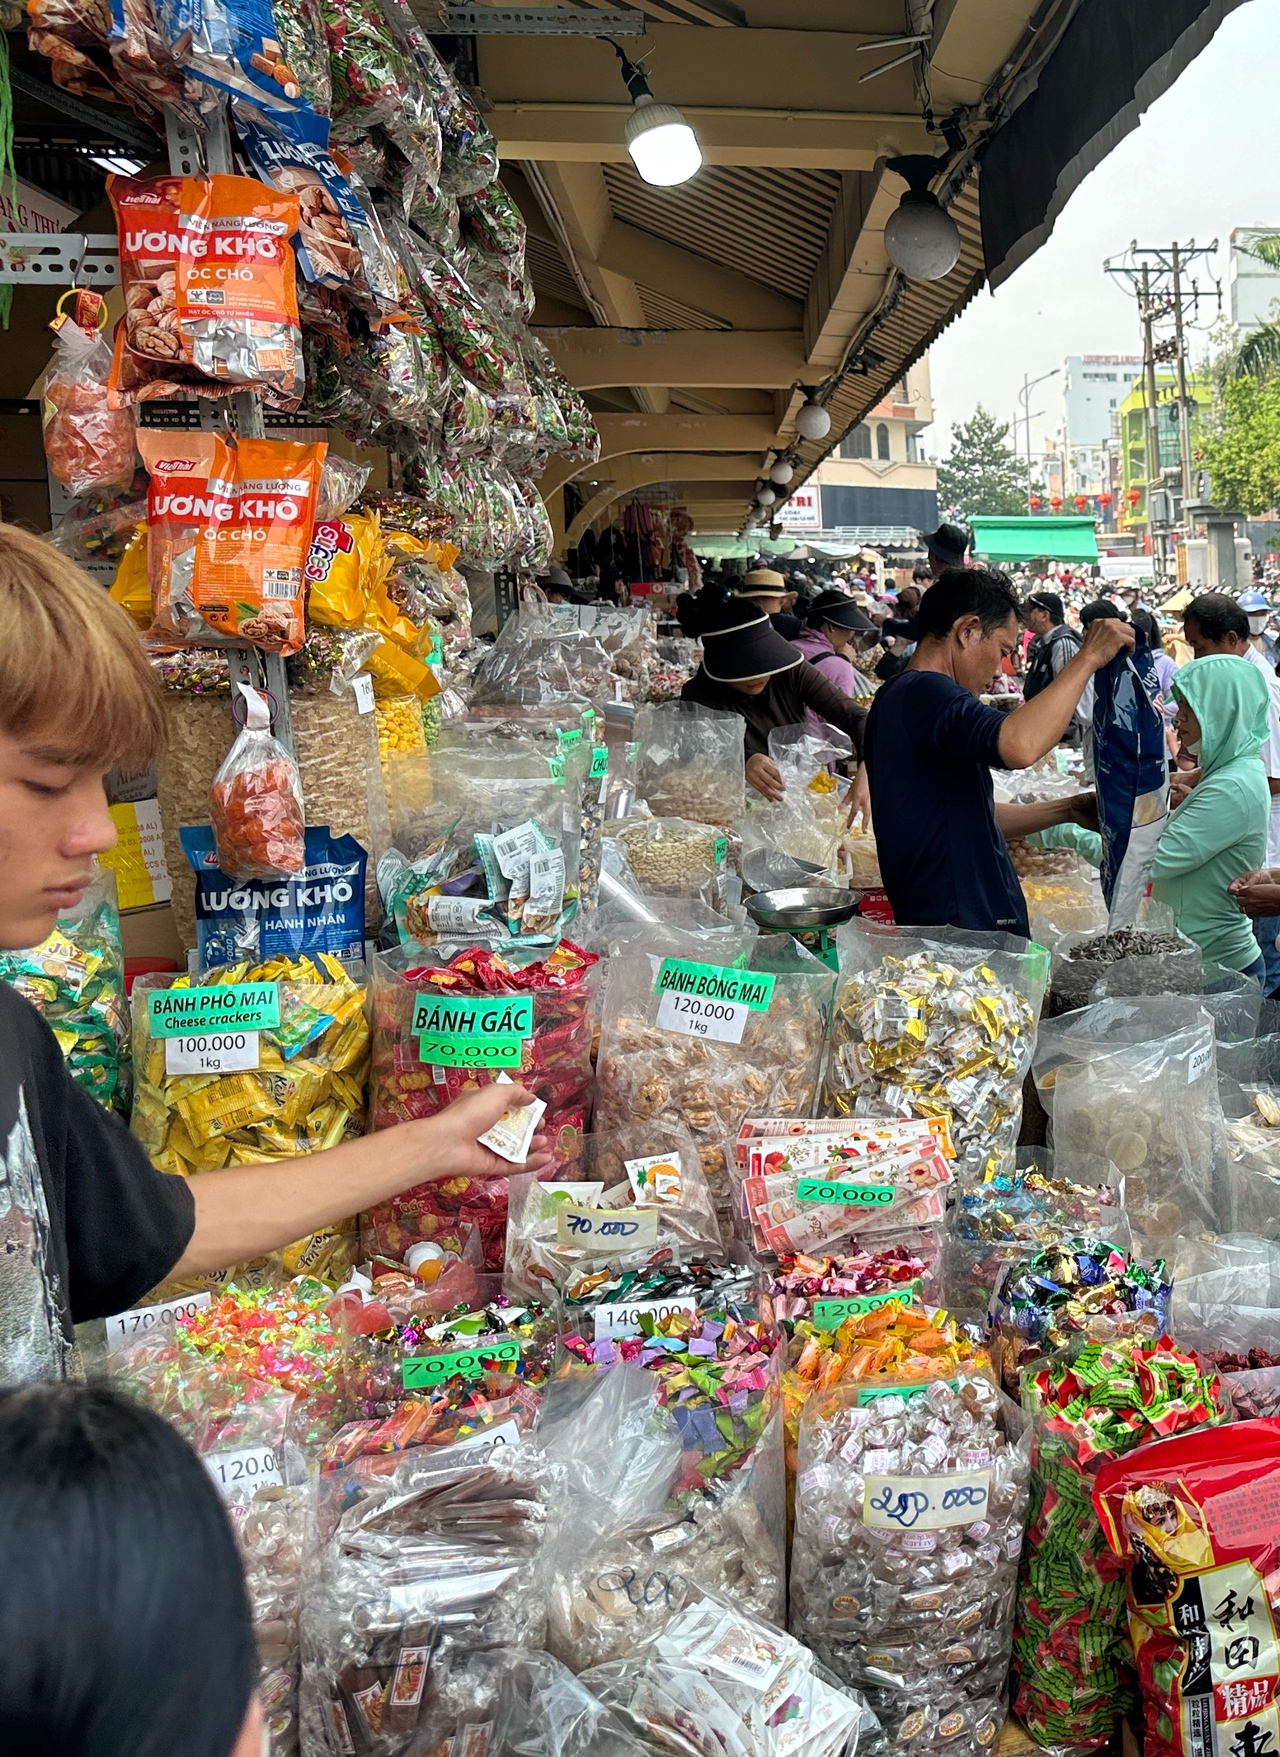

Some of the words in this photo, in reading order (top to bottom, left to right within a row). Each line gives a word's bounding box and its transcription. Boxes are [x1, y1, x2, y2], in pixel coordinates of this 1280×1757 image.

[125, 231, 206, 257] ƯƠNG
[215, 235, 278, 259] KHÔ
[239, 496, 300, 521] KHÔ
[201, 887, 289, 911] LƯƠNG
[297, 878, 353, 908] KHÔ
[265, 919, 304, 932] HẠNH
[308, 914, 346, 928] NHÂN
[660, 967, 697, 993] BÁNH
[696, 974, 739, 1000] BÔNG
[738, 982, 768, 1005] MAI
[153, 995, 197, 1015] BÁNH
[199, 990, 236, 1011] PHÔ
[240, 990, 273, 1007] MAI
[674, 996, 735, 1022] 120.000
[165, 1017, 206, 1029] Cheese
[208, 1011, 262, 1025] crackers
[416, 1004, 476, 1033] BÁNH
[481, 1002, 527, 1032] GẤC
[689, 1020, 708, 1035] 1kg
[178, 1035, 246, 1053] 100.000
[425, 1042, 517, 1057] 70.000
[200, 1057, 221, 1069] 1kg
[451, 1059, 487, 1067] 1KG
[803, 1185, 894, 1203] 70.000
[566, 1214, 640, 1236] 70.000
[117, 1302, 198, 1335] 170.000
[606, 1304, 683, 1328] 140000
[405, 1346, 517, 1376] 70.000
[1221, 1679, 1270, 1718] 精品
